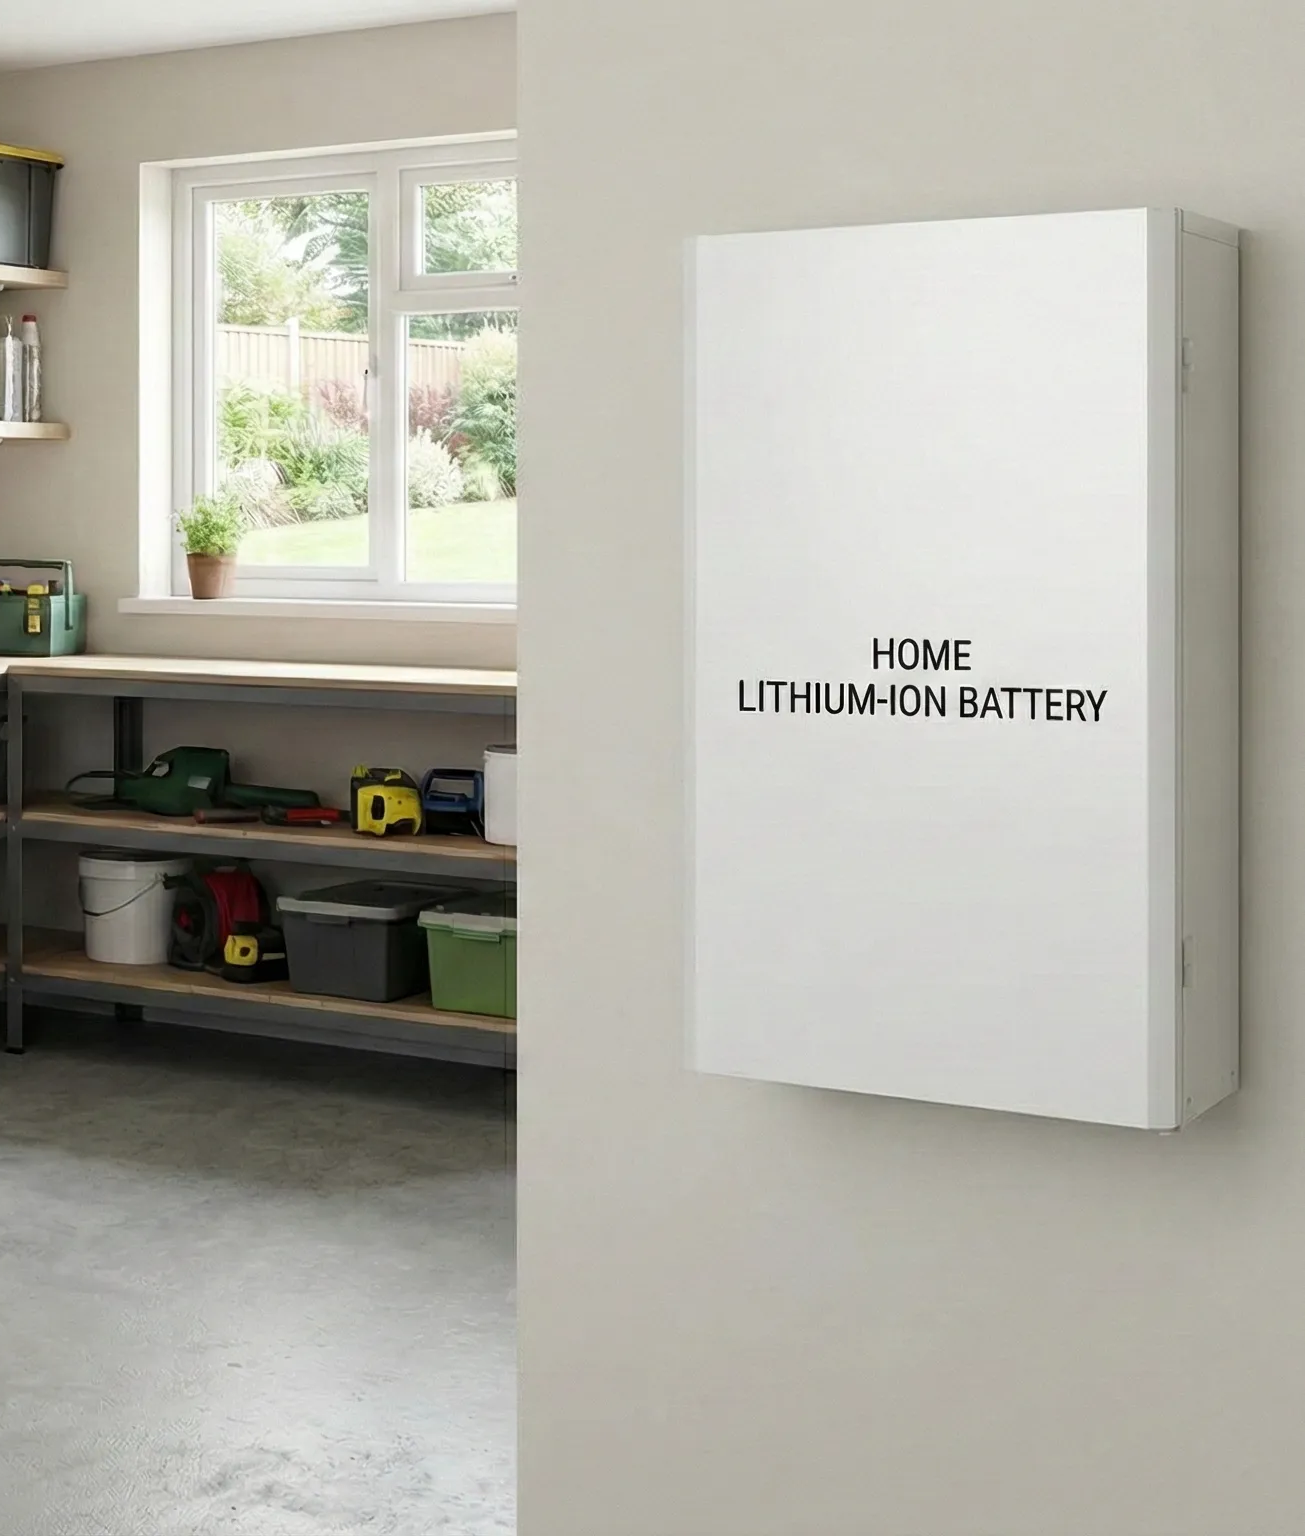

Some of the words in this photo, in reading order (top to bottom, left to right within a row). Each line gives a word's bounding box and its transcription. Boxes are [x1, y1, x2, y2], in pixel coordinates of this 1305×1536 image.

[873, 637, 972, 671] HOME
[738, 679, 946, 718] LITHIUM-ION
[959, 686, 1108, 722] BATTERY
